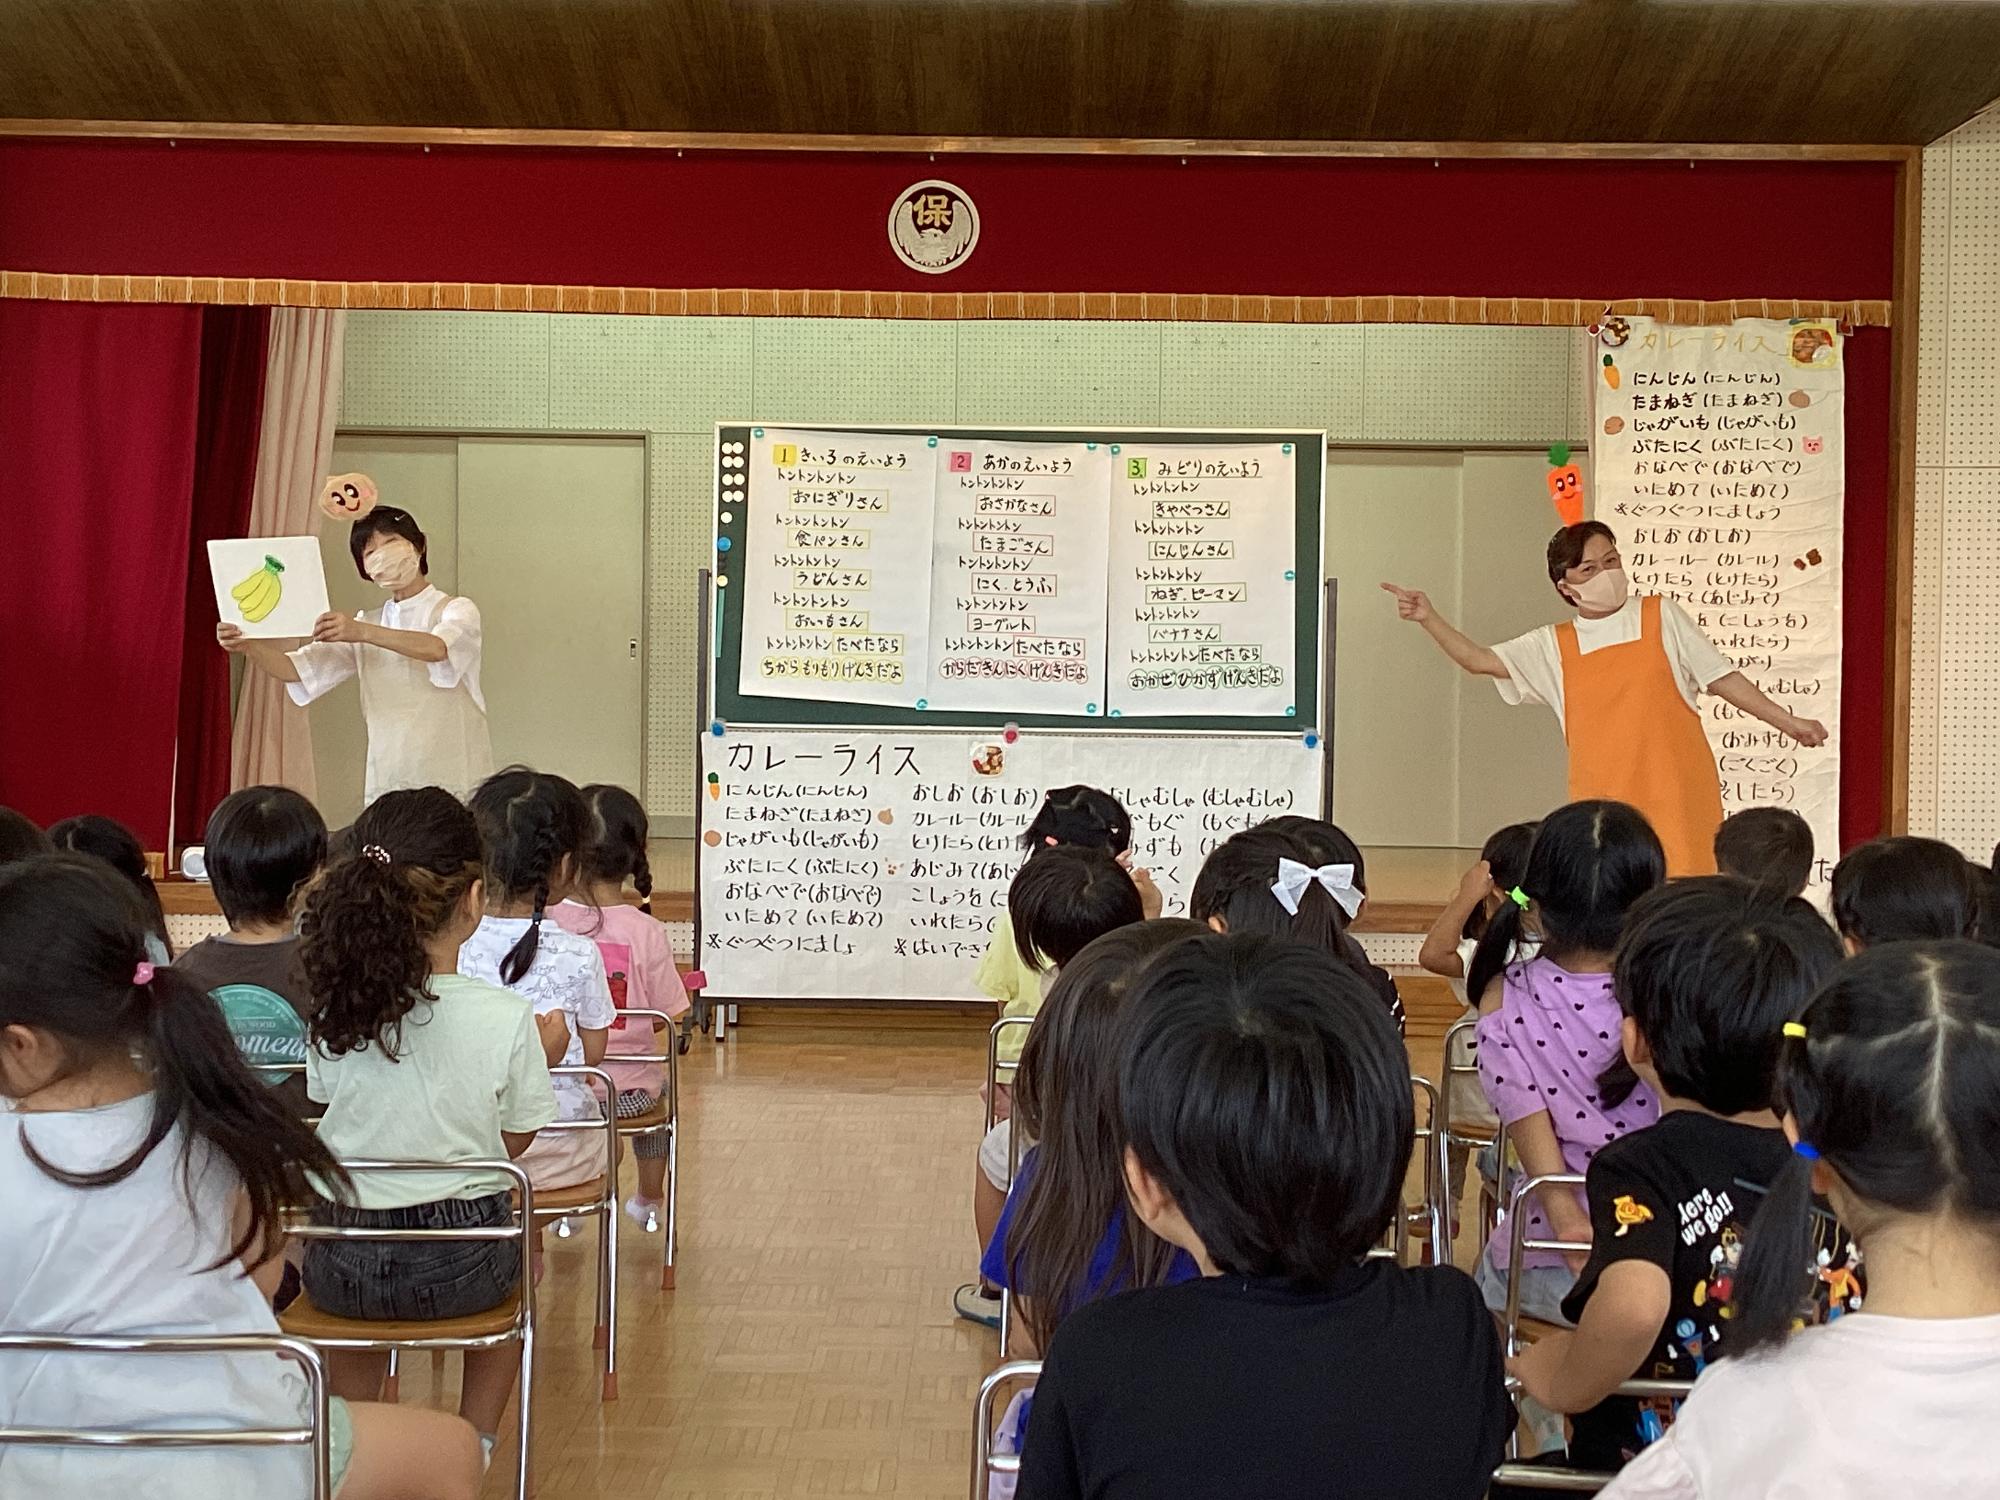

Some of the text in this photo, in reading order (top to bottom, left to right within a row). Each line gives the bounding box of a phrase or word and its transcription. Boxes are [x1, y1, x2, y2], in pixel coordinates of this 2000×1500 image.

[913, 194, 953, 227] 保
[780, 448, 788, 463] 1
[957, 453, 1073, 474] 2 あかのえいよう
[777, 467, 857, 485] トントントントン
[1157, 458, 1261, 477] みどりのえいよう
[960, 475, 1025, 491] トントントントン
[1133, 479, 1201, 497] トントントントン
[792, 489, 883, 510] おにぎりさん
[979, 496, 1053, 515] おさかなさん
[775, 512, 850, 530] トントントントン
[957, 516, 1023, 534] トントントントン
[1134, 519, 1205, 536] トントントントン
[794, 530, 864, 547] 食パンさん
[979, 535, 1050, 555] たまごさん
[1153, 542, 1229, 559] にんじんさん
[773, 553, 841, 569] トントントントン
[958, 555, 1035, 572] トントントントン
[797, 570, 868, 587] うどんさん
[1135, 565, 1203, 583] トントントントン
[773, 591, 850, 609] トントントントン
[956, 596, 1029, 612] トントントントン
[1134, 606, 1201, 623] トントントントン
[972, 617, 1031, 631] ヨーグルト
[1152, 627, 1219, 641] バナナさん
[728, 743, 921, 776] カレーライス
[1681, 1191, 1734, 1246] we go!!
